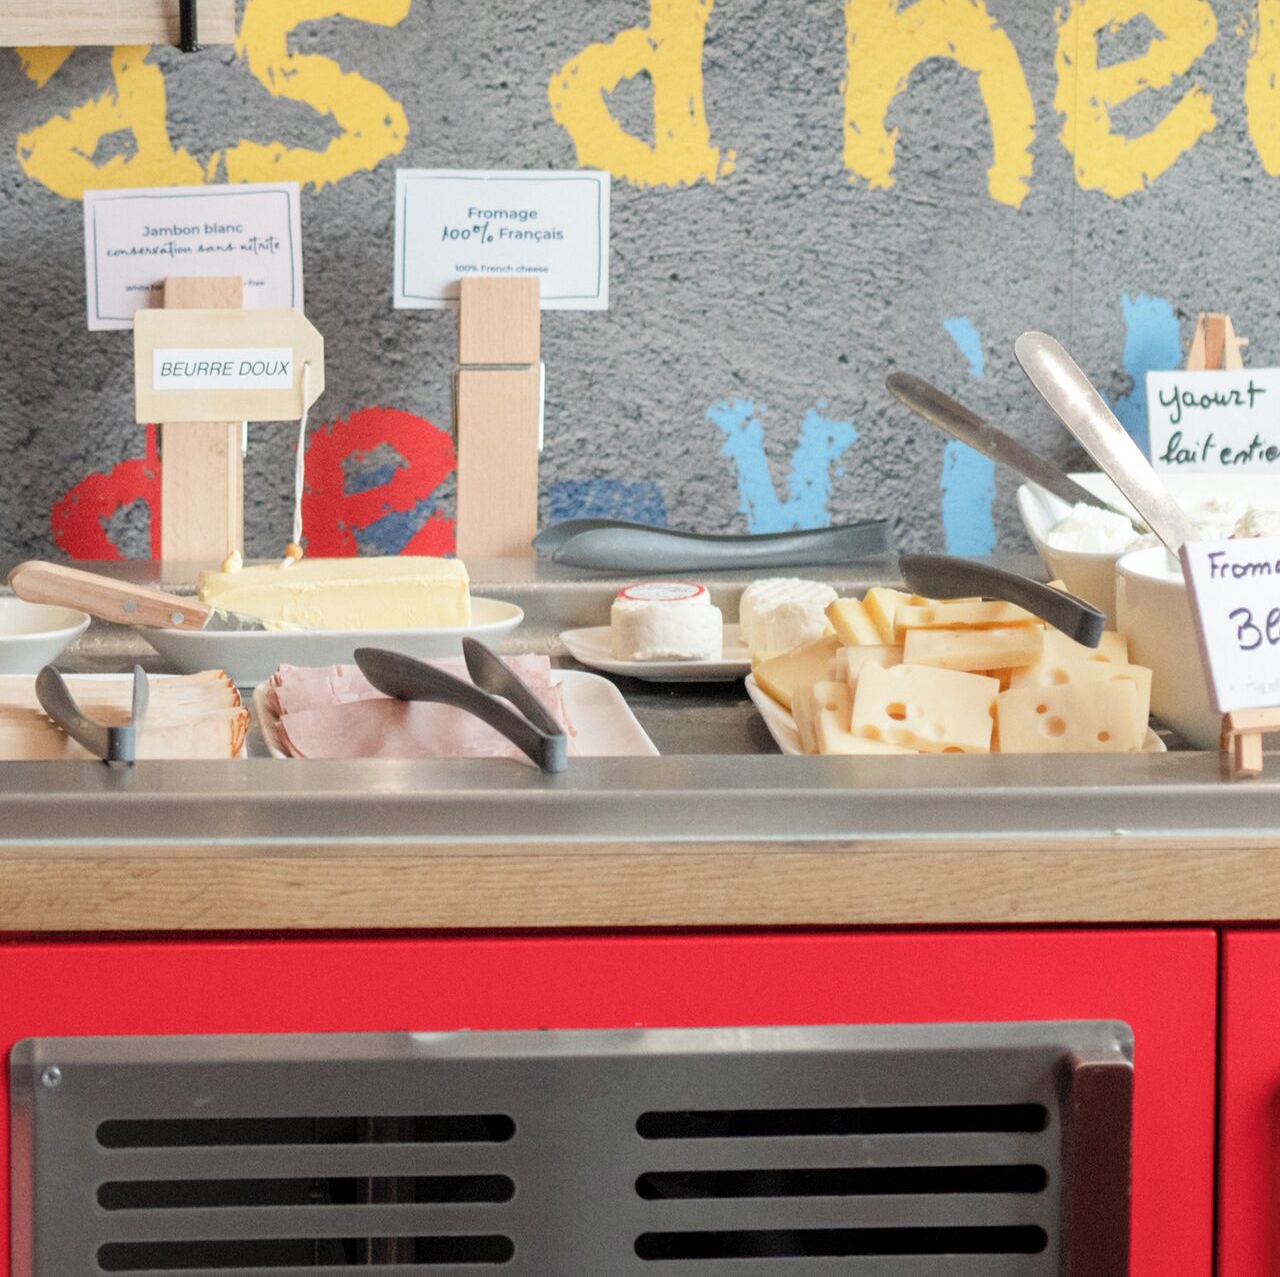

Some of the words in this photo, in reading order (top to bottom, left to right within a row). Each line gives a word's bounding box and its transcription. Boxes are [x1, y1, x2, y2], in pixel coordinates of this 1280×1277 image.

[468, 207, 538, 221] Fromage
[143, 224, 201, 238] Jambon
[205, 222, 243, 235] blanc
[441, 220, 494, 245] 100%
[498, 226, 564, 243] Français
[106, 240, 193, 259] conservation
[197, 240, 237, 254] sans
[239, 235, 281, 256] nitrite
[481, 264, 514, 273] French
[516, 264, 549, 273] cheese
[160, 361, 234, 377] BEURRE
[238, 360, 290, 376] DOUX
[1159, 430, 1215, 465] lait
